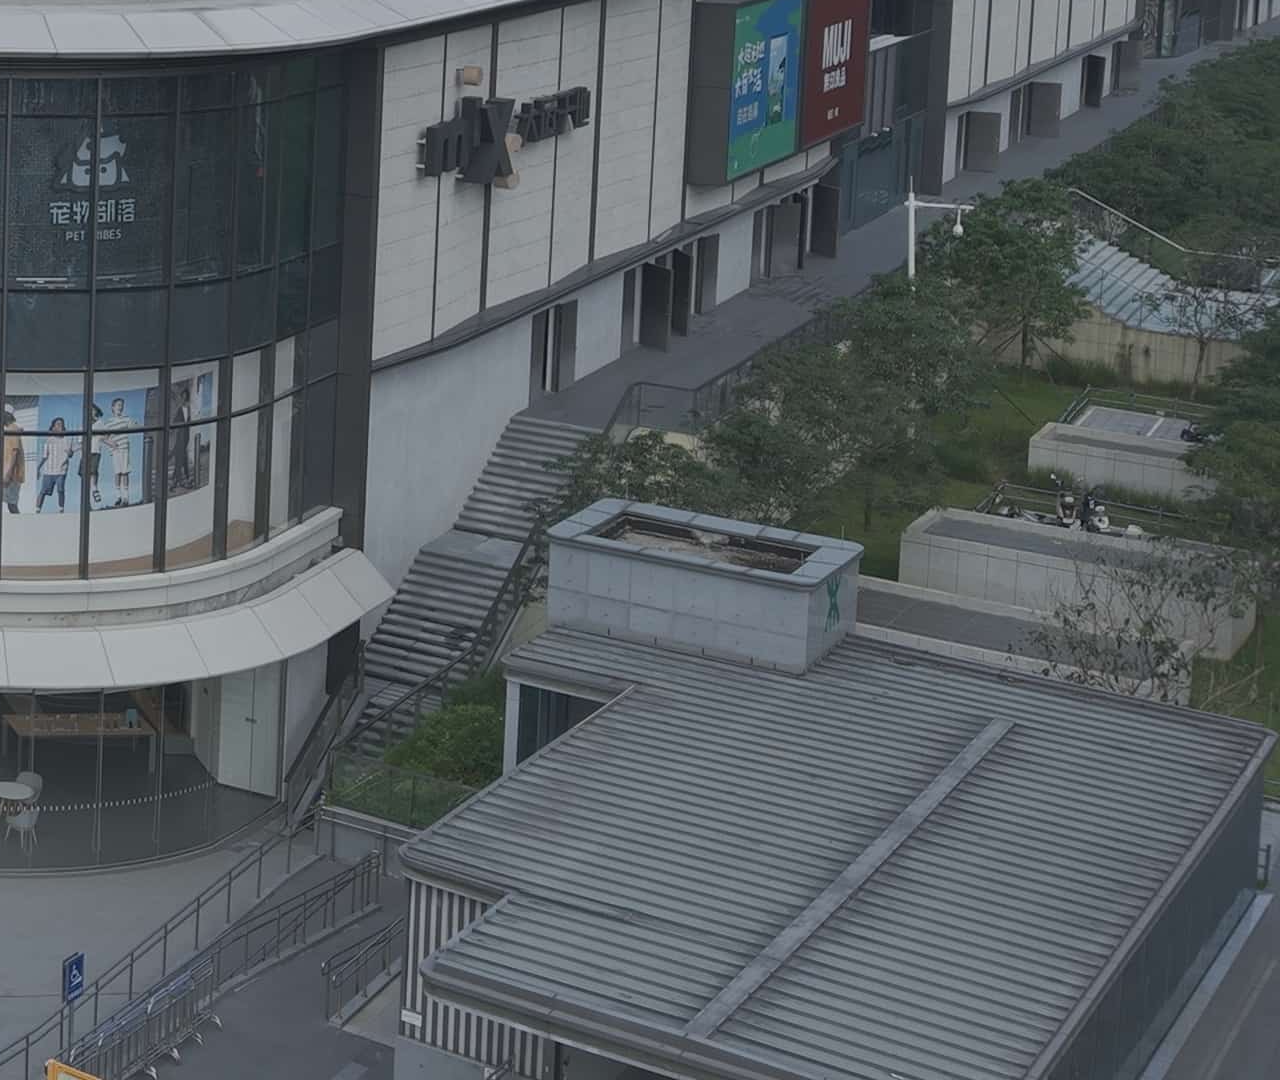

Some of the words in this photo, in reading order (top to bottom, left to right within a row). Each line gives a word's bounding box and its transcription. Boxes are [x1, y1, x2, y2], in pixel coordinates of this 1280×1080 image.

[822, 18, 852, 71] MUJI
[49, 198, 137, 225] 宠物部落
[65, 230, 86, 241] PET
